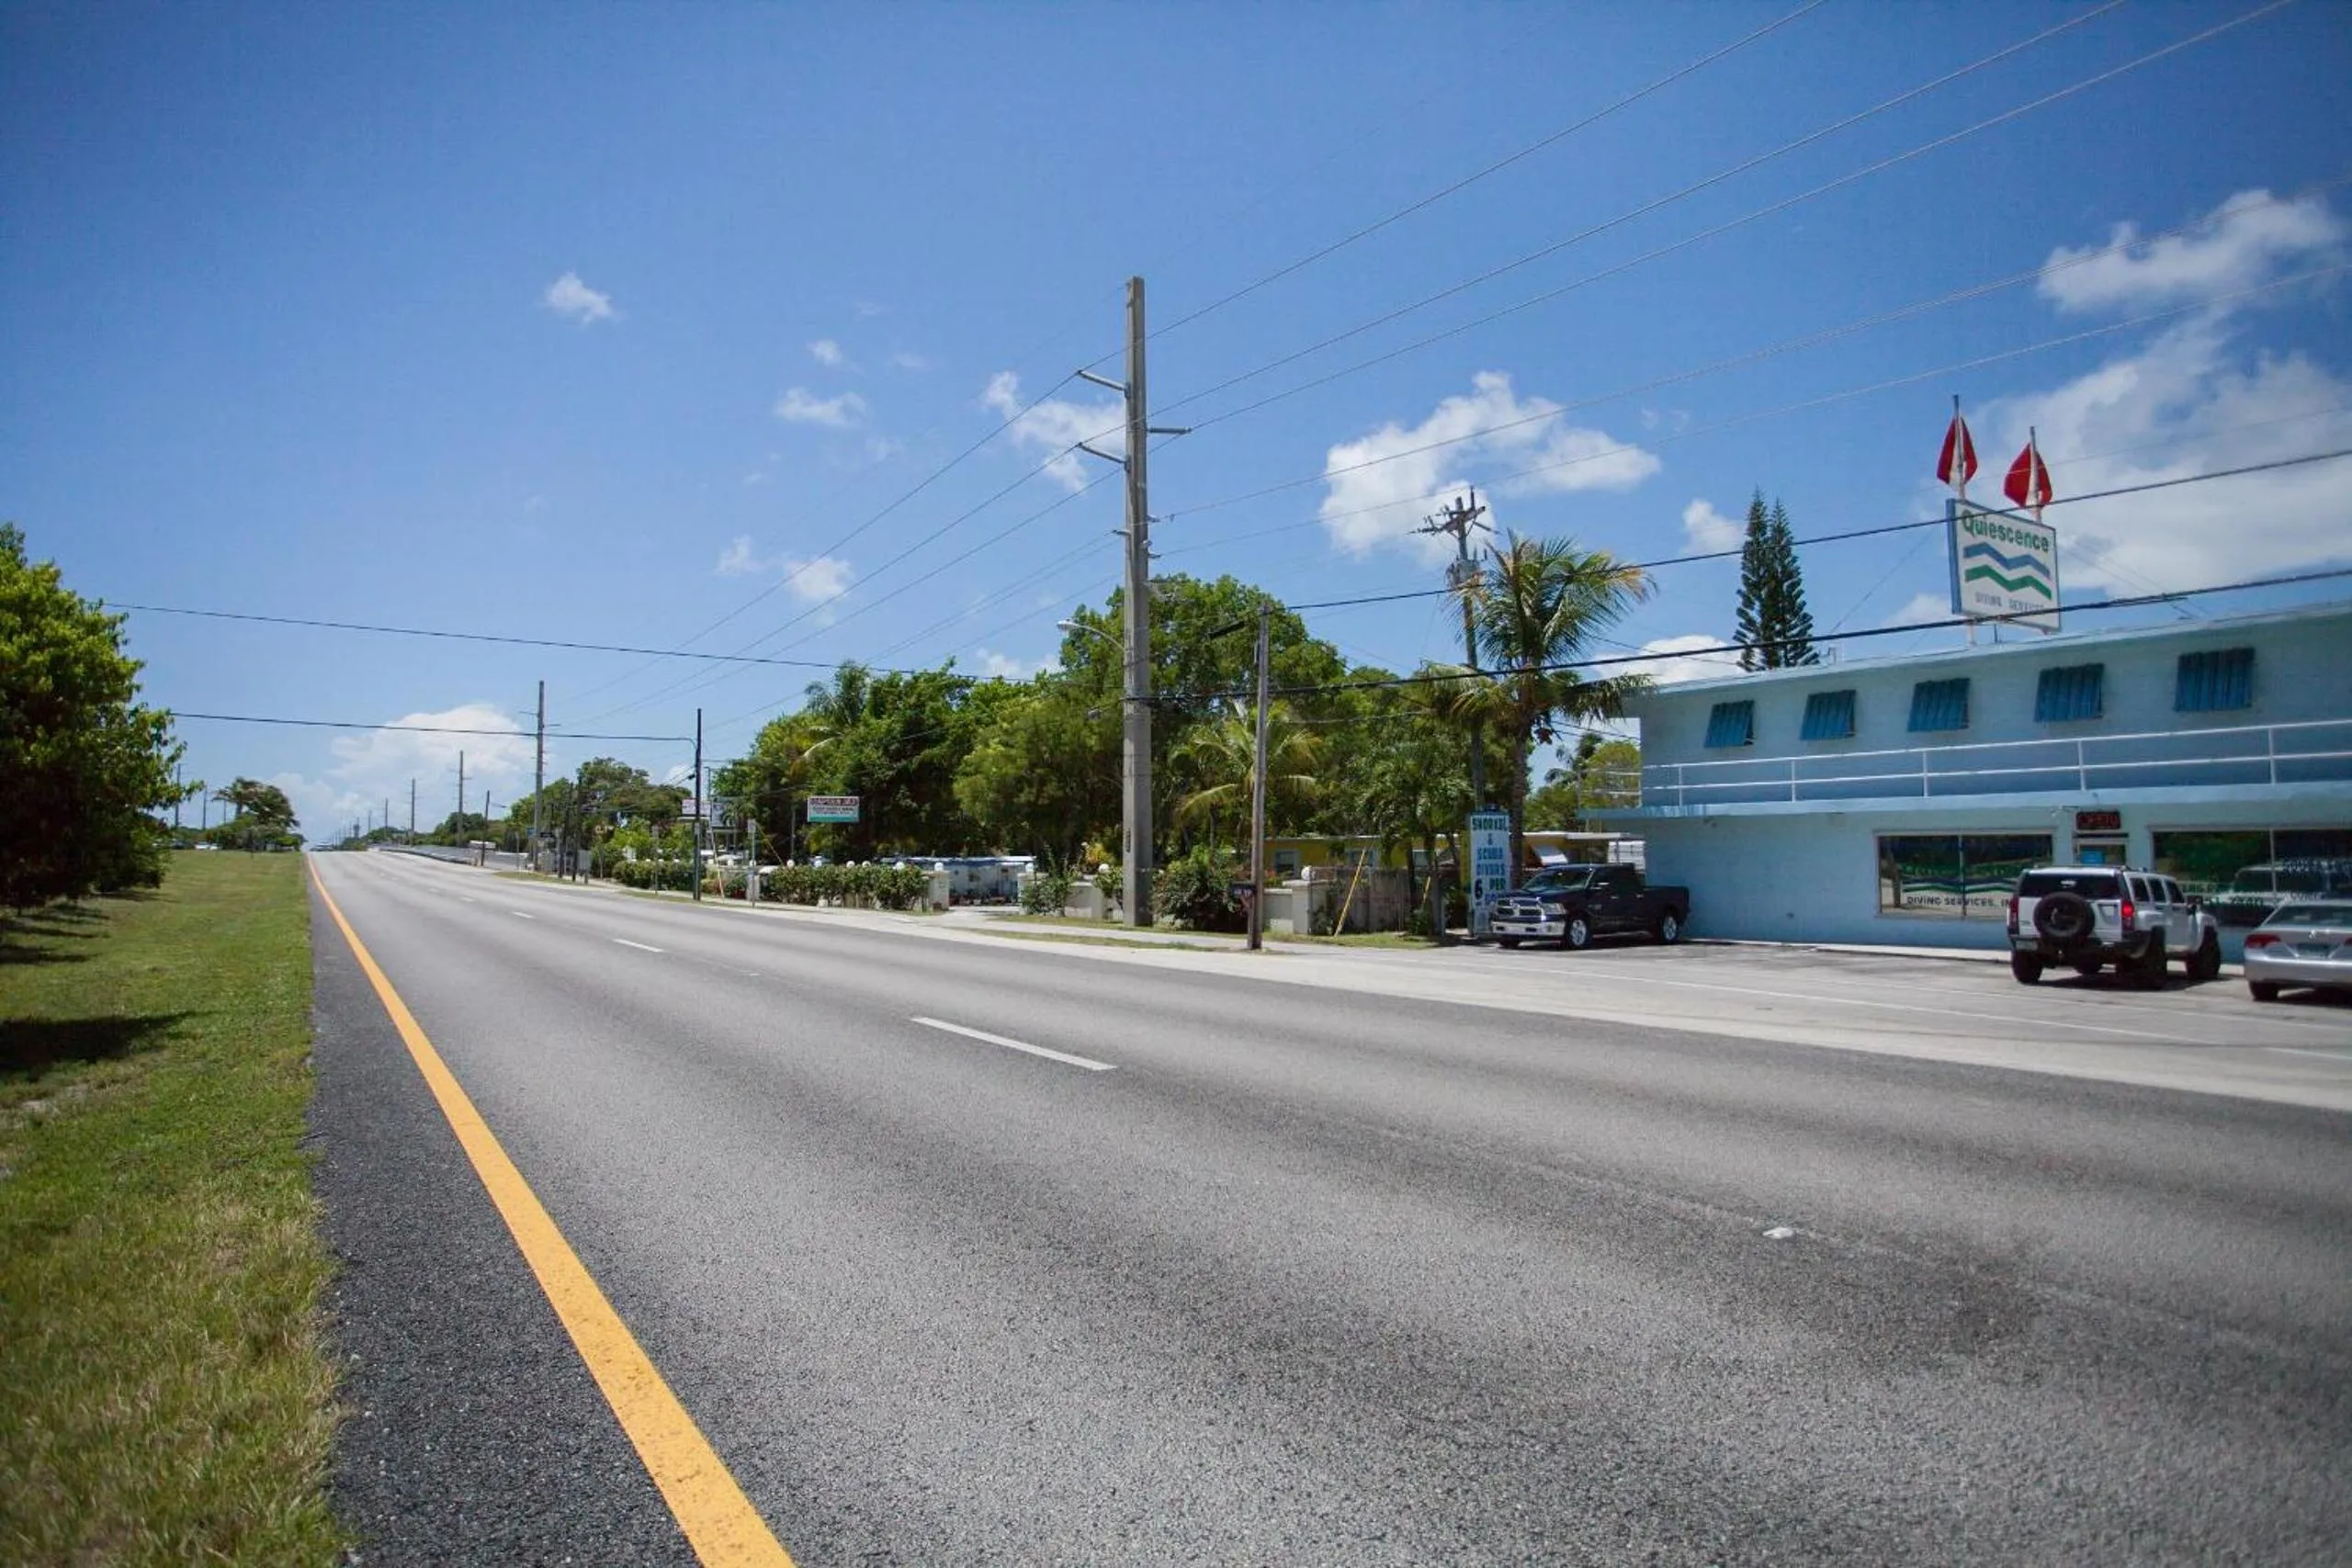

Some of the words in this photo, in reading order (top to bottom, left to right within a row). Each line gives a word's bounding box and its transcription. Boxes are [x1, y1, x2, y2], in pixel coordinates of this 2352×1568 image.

[1962, 509, 2049, 552] Quiescence
[1477, 848, 1503, 860] SCUBA
[1475, 878, 1483, 899] 6
[1489, 878, 1506, 890] PER
[1906, 897, 1941, 905] DIVING
